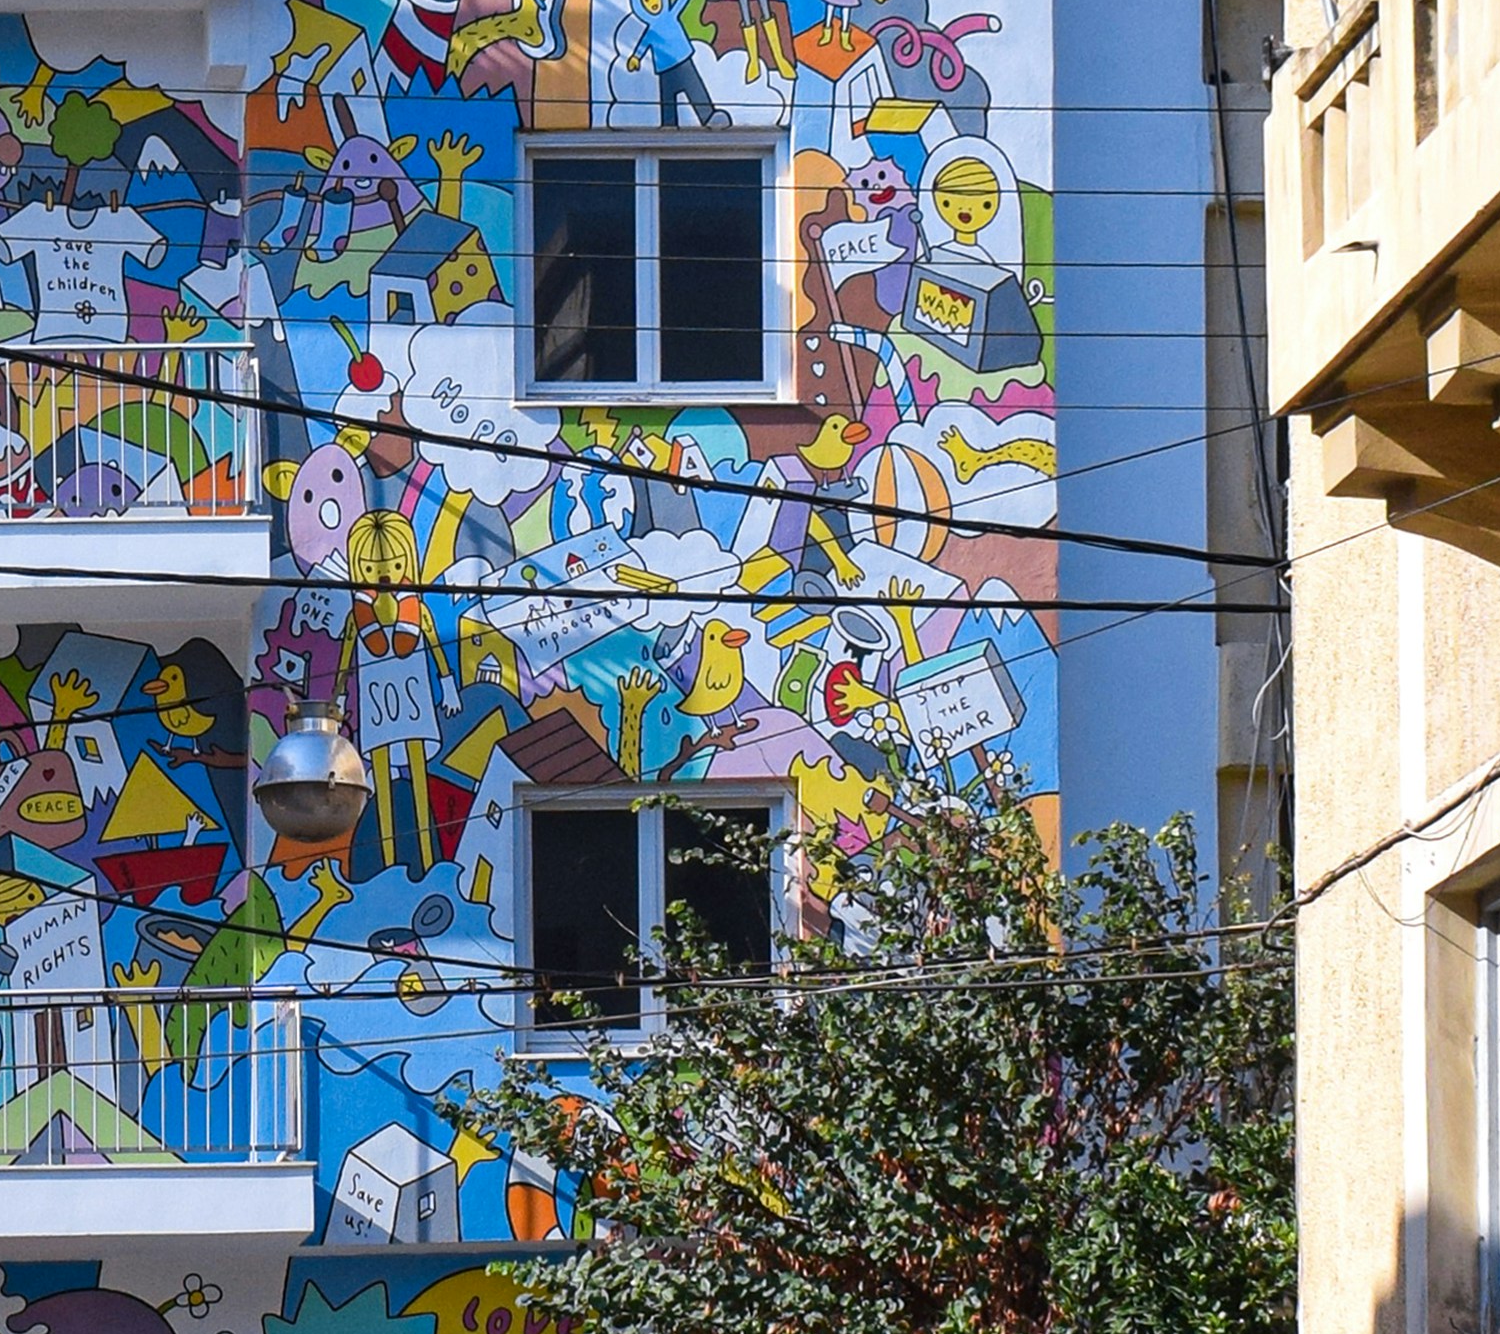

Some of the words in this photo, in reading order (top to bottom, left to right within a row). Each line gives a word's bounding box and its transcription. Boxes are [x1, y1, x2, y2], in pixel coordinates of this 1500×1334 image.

[53, 237, 93, 255] Save
[828, 235, 878, 264] PEACE
[63, 255, 90, 271] the
[47, 276, 117, 301] children
[921, 292, 960, 320] WAR
[310, 591, 331, 605] are
[301, 603, 332, 627] ONE
[368, 676, 420, 727] SOS
[917, 676, 967, 705] STOP
[938, 697, 971, 717] THE
[950, 713, 994, 740] WAR
[26, 800, 77, 815] PEACE
[22, 902, 87, 950] HUMAN
[22, 936, 91, 988] RIGHTS
[346, 1173, 384, 1214] Save
[344, 1214, 374, 1240] us!
